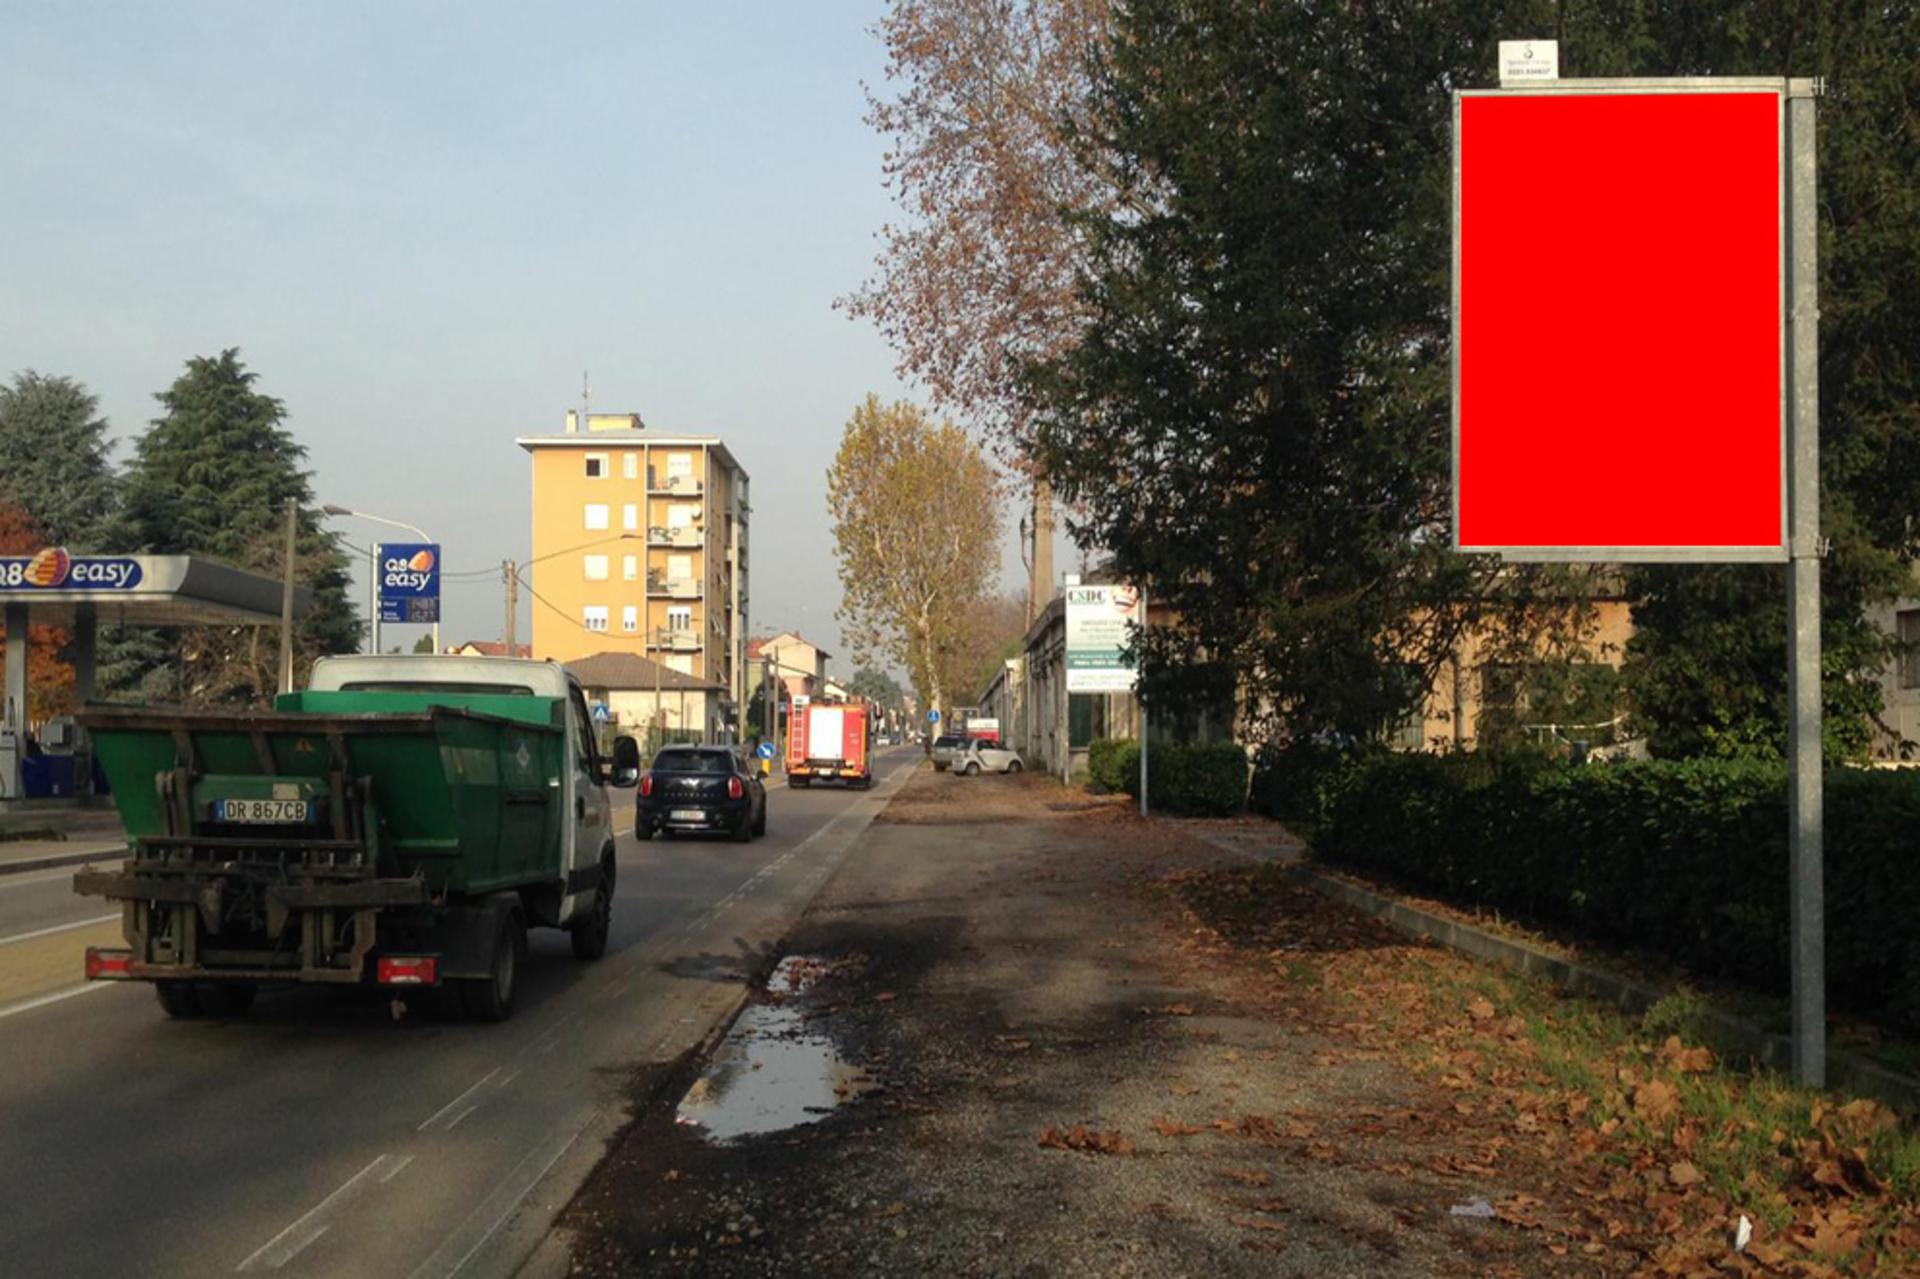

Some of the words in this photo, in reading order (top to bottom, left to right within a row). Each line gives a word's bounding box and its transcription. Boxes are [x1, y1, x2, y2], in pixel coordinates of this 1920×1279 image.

[384, 558, 408, 572] Q8
[71, 563, 134, 587] easy
[384, 572, 431, 591] easy
[227, 802, 247, 819] DR
[252, 802, 305, 819] 867CB
